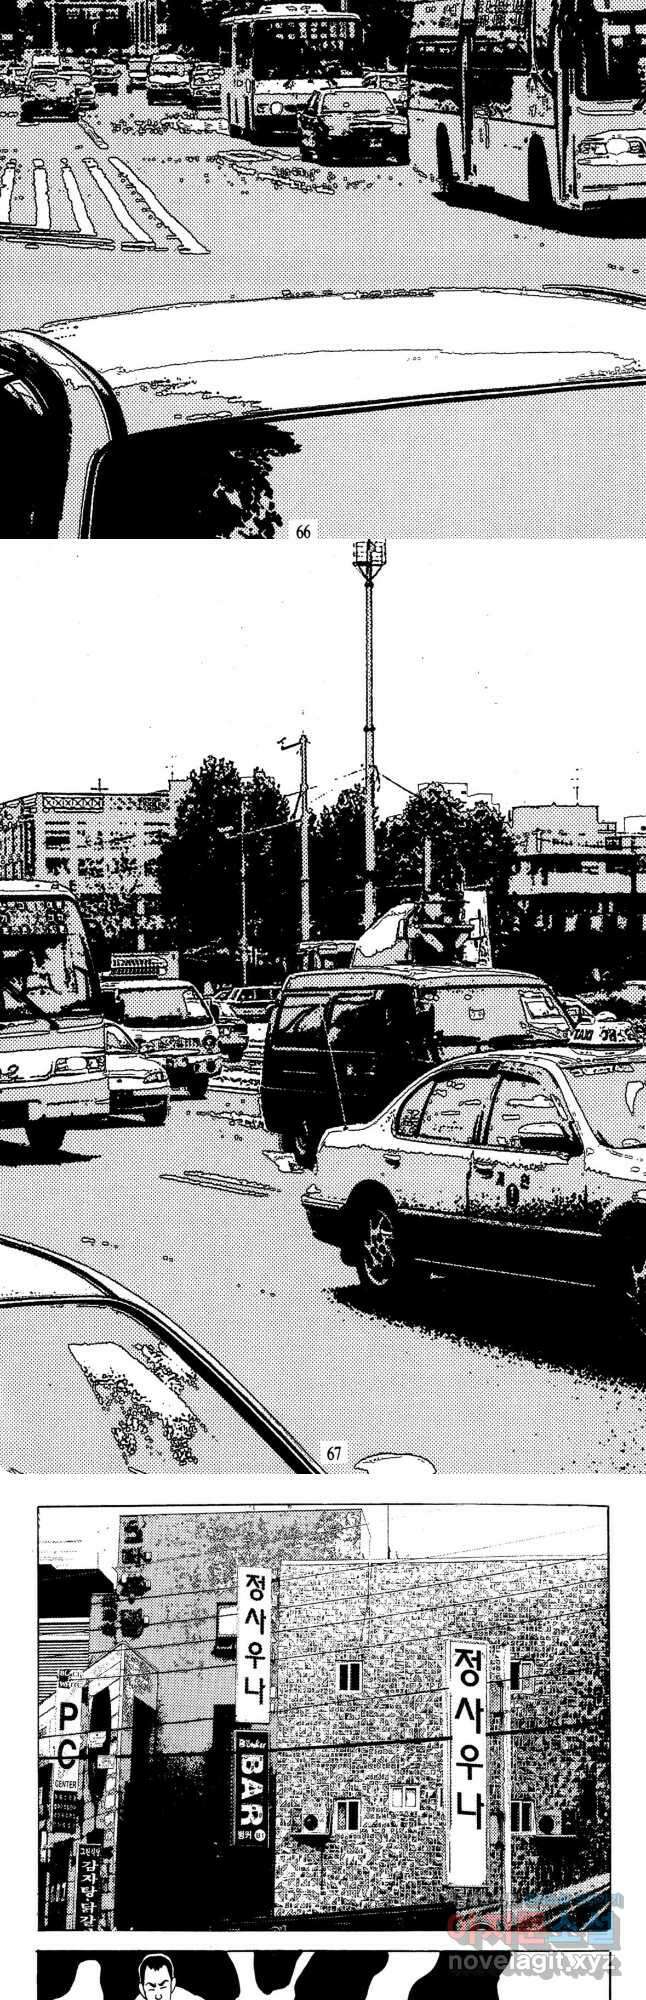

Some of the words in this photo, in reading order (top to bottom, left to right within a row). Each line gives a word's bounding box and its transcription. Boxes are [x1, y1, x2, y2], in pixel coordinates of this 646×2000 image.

[296, 524, 311, 539] 66
[327, 1446, 341, 1461] 67
[245, 1574, 266, 1705] 정사우나
[57, 1702, 79, 1770] PC
[454, 1648, 484, 1830] 정사우나
[54, 1780, 77, 1789] CENTER
[240, 1754, 264, 1826] BAR
